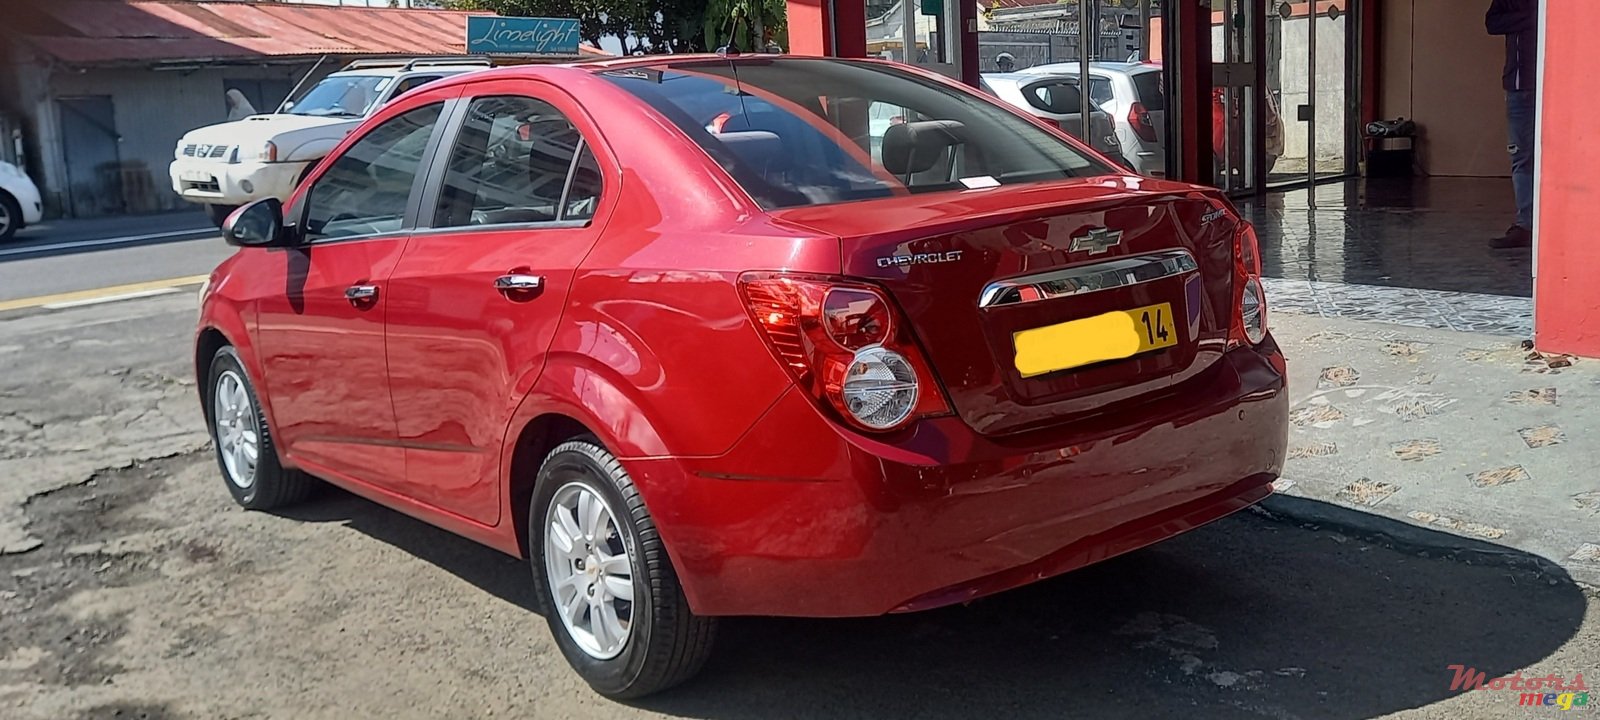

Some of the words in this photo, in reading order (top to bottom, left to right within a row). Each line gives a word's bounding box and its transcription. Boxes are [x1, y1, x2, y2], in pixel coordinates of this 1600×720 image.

[471, 19, 578, 52] Limelight
[876, 249, 964, 268] CHEVROLET
[1141, 308, 1169, 346] 14
